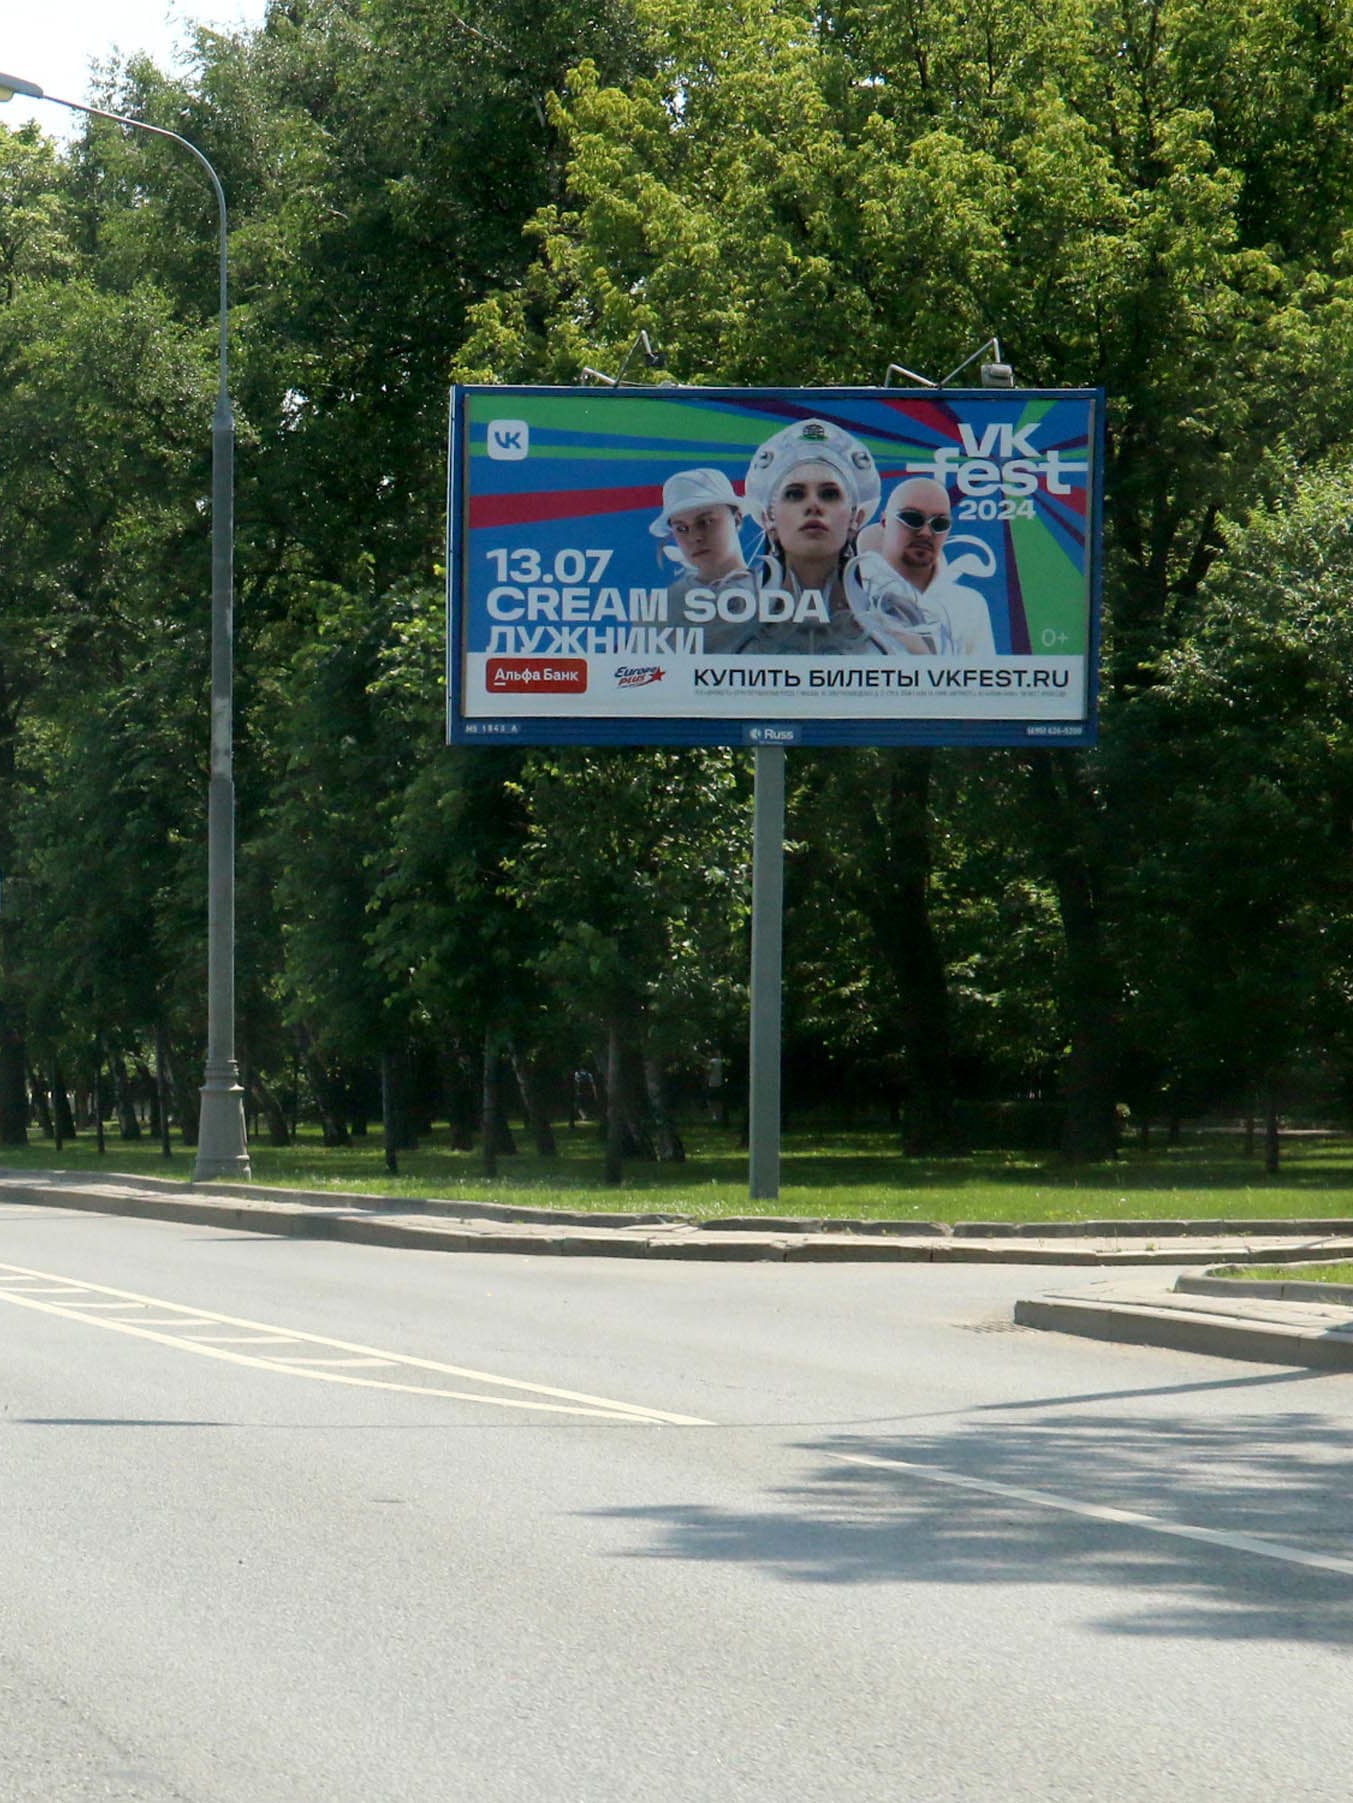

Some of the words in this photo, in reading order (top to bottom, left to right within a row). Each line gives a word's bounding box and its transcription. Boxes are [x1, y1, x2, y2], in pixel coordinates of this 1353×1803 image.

[494, 431, 522, 449] VK
[957, 422, 1041, 458] VK
[905, 447, 1090, 497] fest
[958, 499, 1037, 520] 2024
[485, 548, 614, 584] 13.07
[486, 586, 669, 622] CREAM
[683, 587, 831, 623] SODA
[485, 626, 705, 655] ЛУЖНИКИ
[494, 667, 541, 686] Альфа
[543, 668, 579, 682] Банк
[694, 669, 801, 687] КУПИТЬ
[809, 669, 919, 687] БИЛЕТЫ
[927, 670, 1069, 688] VKFEST.RU
[764, 728, 794, 740] Russ
